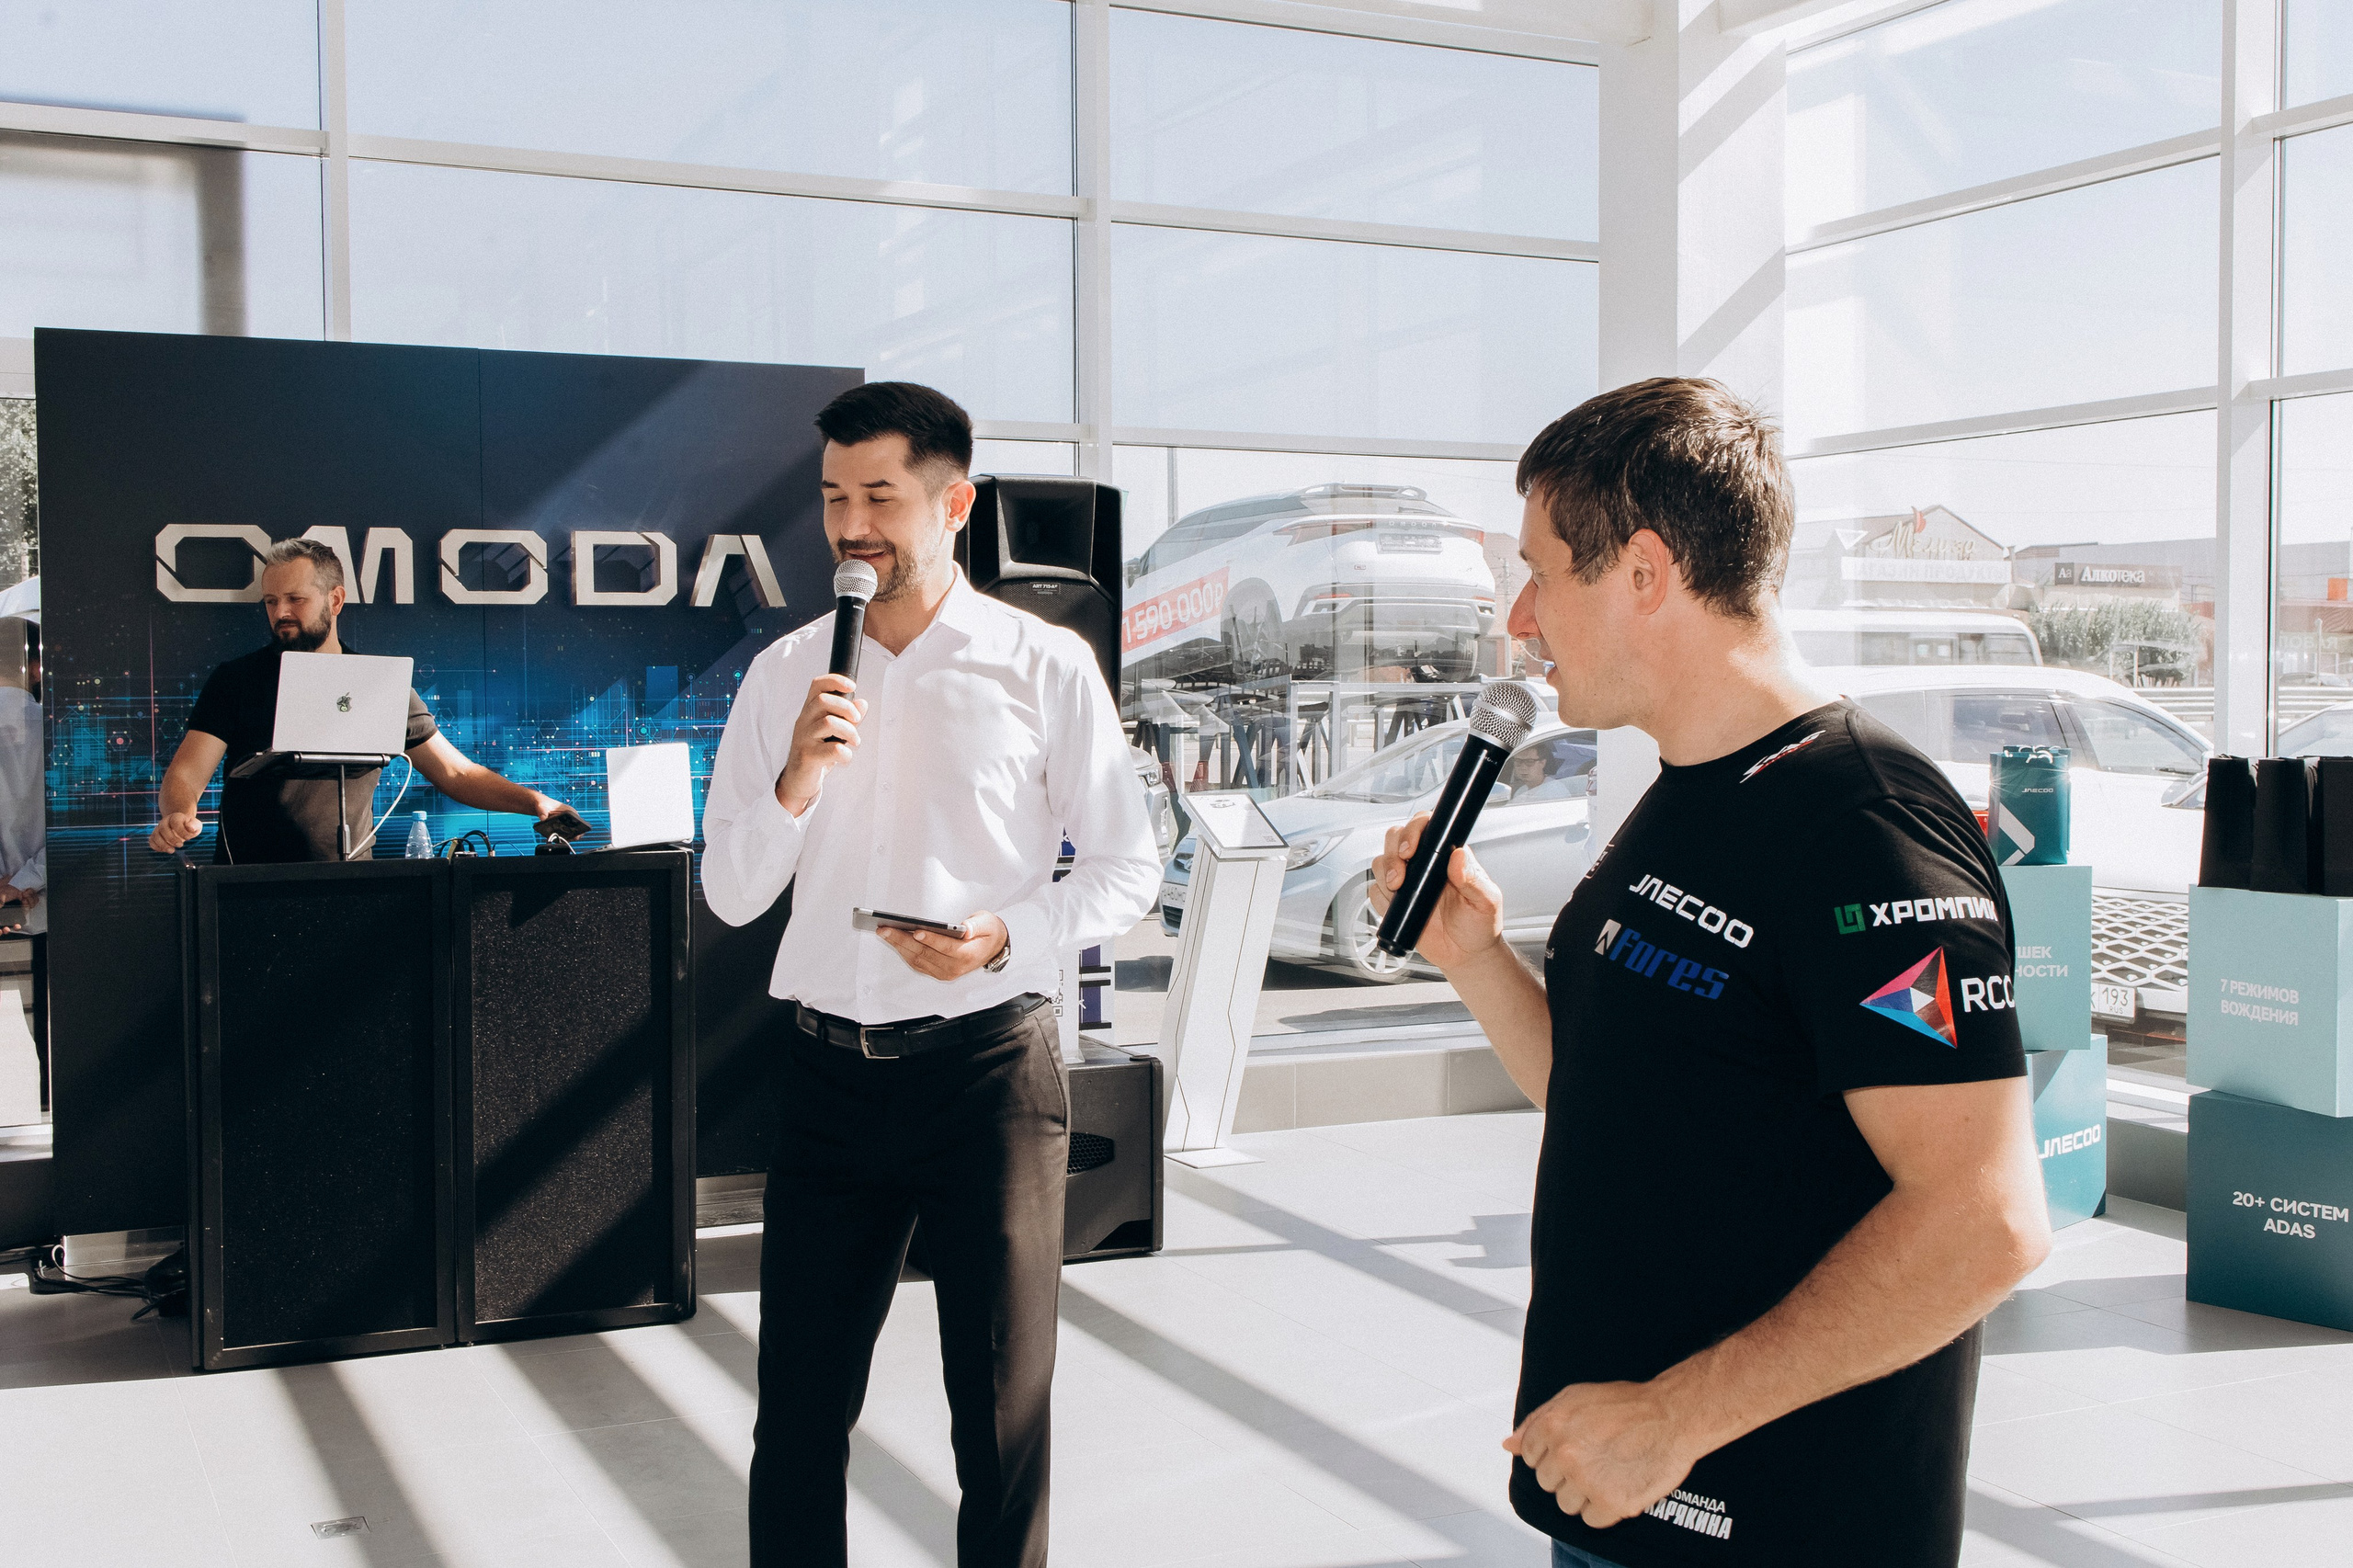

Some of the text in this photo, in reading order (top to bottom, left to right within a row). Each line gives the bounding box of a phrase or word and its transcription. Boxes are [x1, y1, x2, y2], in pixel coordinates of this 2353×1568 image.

[154, 524, 787, 608] OMODA
[2081, 565, 2146, 584] Алкотека
[1629, 874, 1754, 949] JAECOO
[1870, 896, 1998, 927] ХРОМПИК
[1609, 927, 1729, 1000] fores
[2015, 946, 2052, 959] ШЕК
[2102, 986, 2129, 1006] 193
[2221, 978, 2300, 1005] 7 РЕЖИМОВ
[2109, 1006, 2124, 1015] RUS
[2221, 999, 2299, 1026] ВОЖДЕНИЯ
[2038, 1123, 2102, 1159] JAECOO
[2232, 1190, 2349, 1222] 20+ СИСТЕМ
[2263, 1218, 2316, 1239] ADAS
